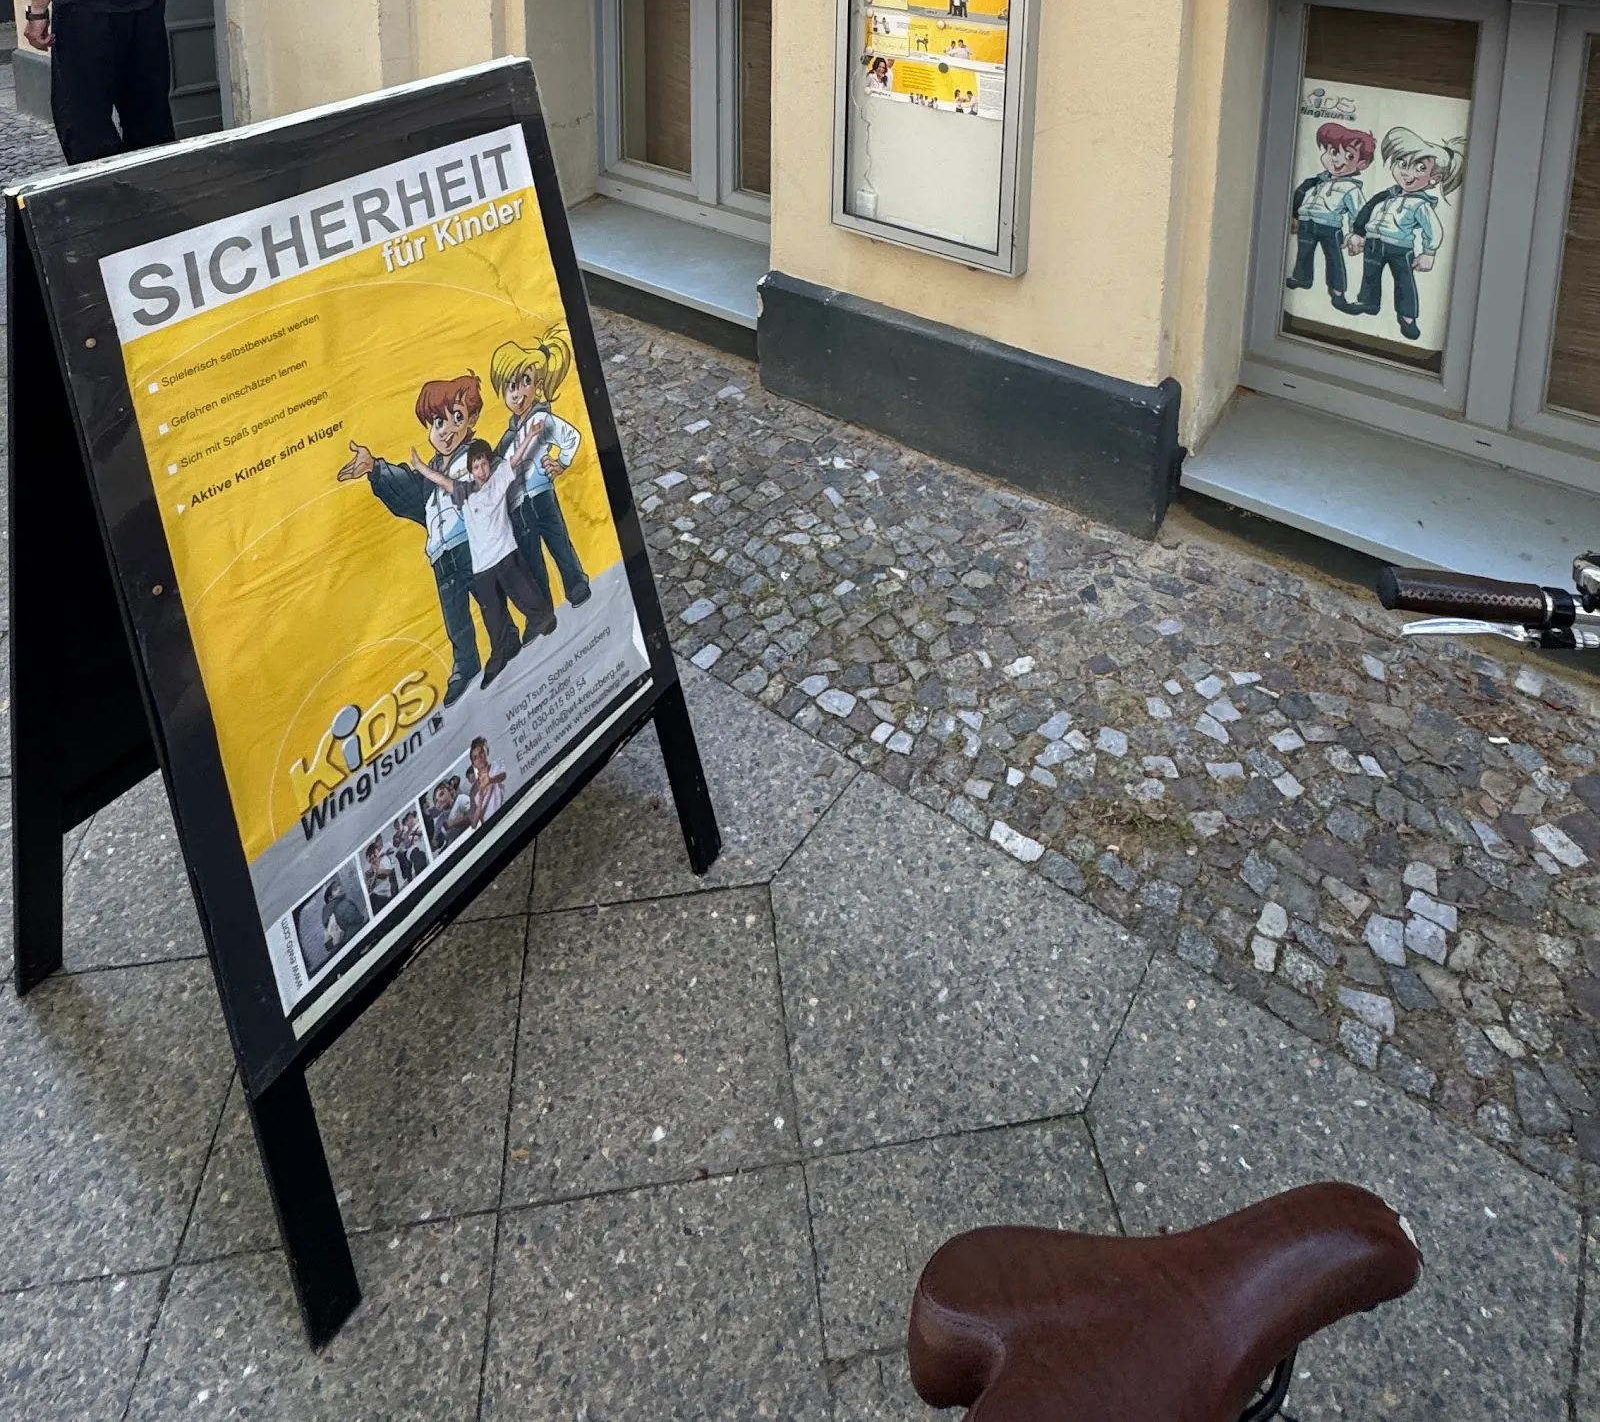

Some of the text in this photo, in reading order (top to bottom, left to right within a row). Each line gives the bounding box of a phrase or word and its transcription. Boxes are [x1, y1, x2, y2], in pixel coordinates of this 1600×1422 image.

[128, 144, 512, 326] SICHERHEIT
[381, 196, 524, 273] für Kinder
[161, 313, 320, 387] Spielerisch selbstbewusst werden
[171, 359, 308, 428] Gefahren einschätzen lernen
[180, 390, 329, 469] Sich mit Spaß gesund bewegen
[191, 418, 345, 508] Aktive Kinder sind klüger
[505, 625, 612, 722] WingTsun Schule Kreuzberg
[509, 716, 527, 735] Sifu
[549, 675, 572, 701] Zuber
[515, 659, 627, 763] E-Mail: info@wt-kreuzberg.de
[532, 699, 565, 730] 030-615
[564, 688, 576, 702] 89
[576, 677, 588, 691] 54
[301, 730, 424, 842] WingTsun
